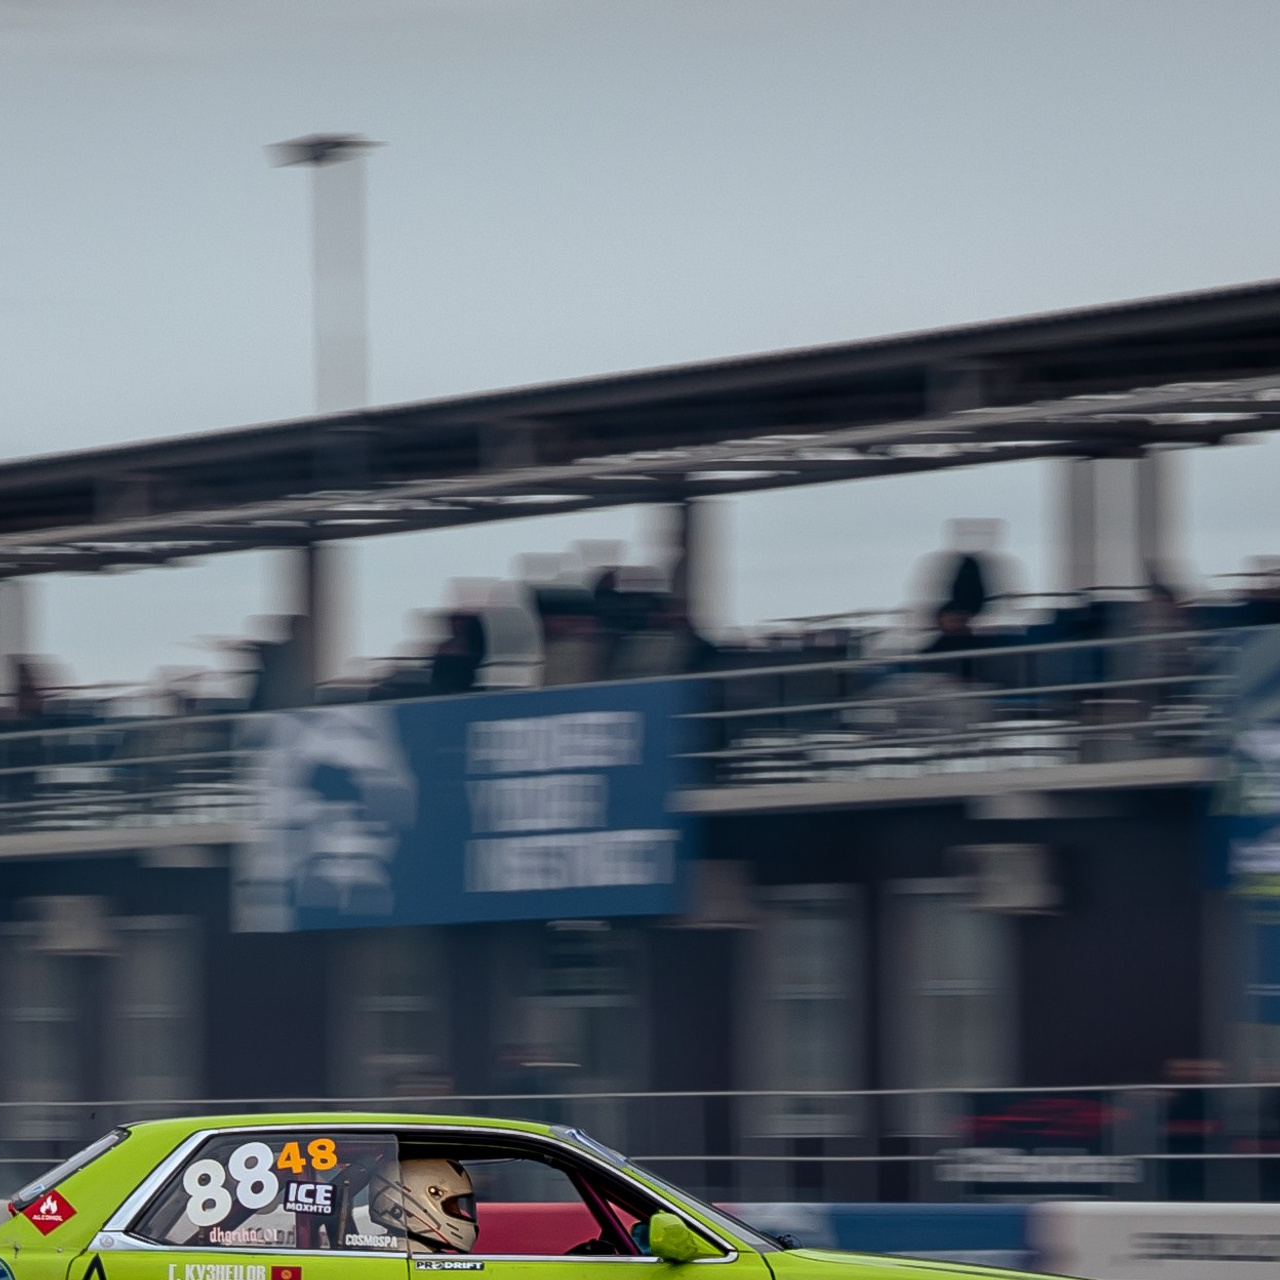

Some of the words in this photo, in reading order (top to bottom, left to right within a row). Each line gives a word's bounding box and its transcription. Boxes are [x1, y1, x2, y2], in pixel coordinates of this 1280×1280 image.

[277, 1138, 338, 1174] 48
[183, 1141, 279, 1228] 88
[289, 1183, 333, 1205] ICE
[286, 1203, 332, 1214] МОХИТО
[345, 1234, 398, 1248] COSMOSPA
